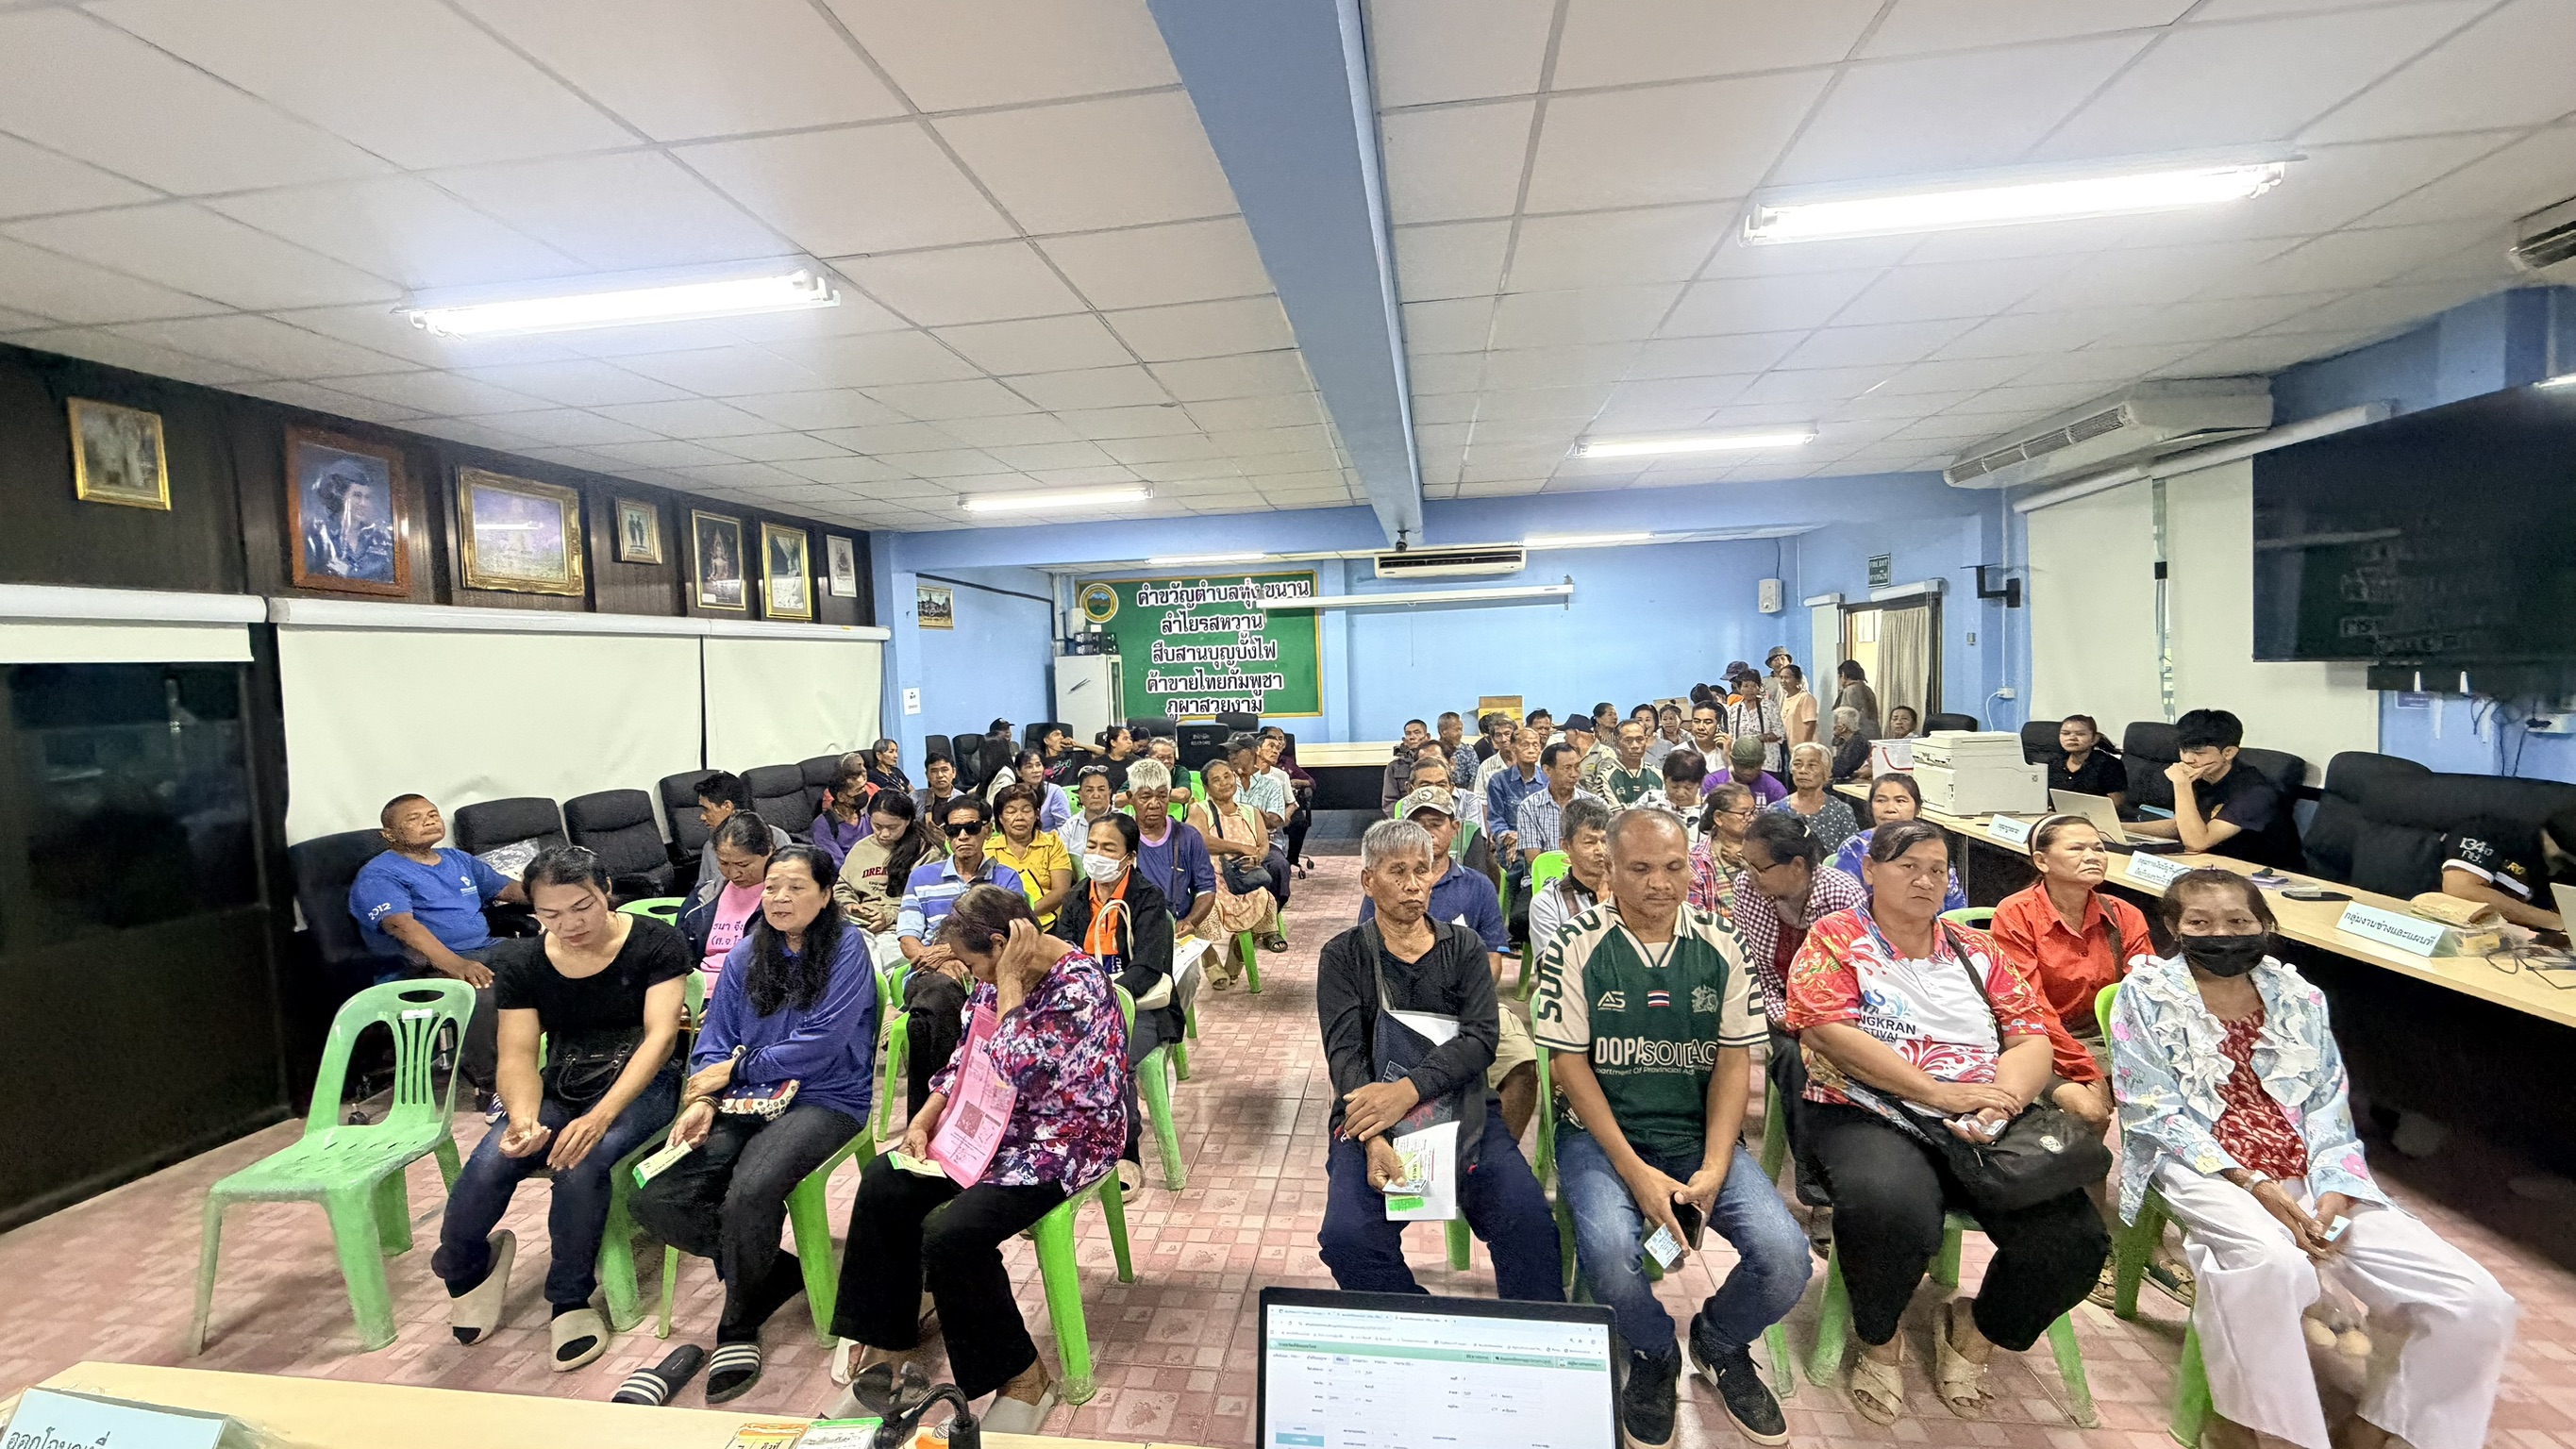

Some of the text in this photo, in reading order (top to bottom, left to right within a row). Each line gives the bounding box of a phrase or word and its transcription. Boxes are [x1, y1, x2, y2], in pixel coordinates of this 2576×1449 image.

[1162, 610, 1263, 633] ลำไยรสหวาน
[1153, 632, 1276, 668] สืบสานบุญบั้งไฟ
[1147, 669, 1282, 696] ค้าขายไทยกัมพูชา
[861, 866, 888, 878] DREA
[1860, 1014, 1916, 1035] NGKRAN
[1643, 1066, 1681, 1074] Provincial
